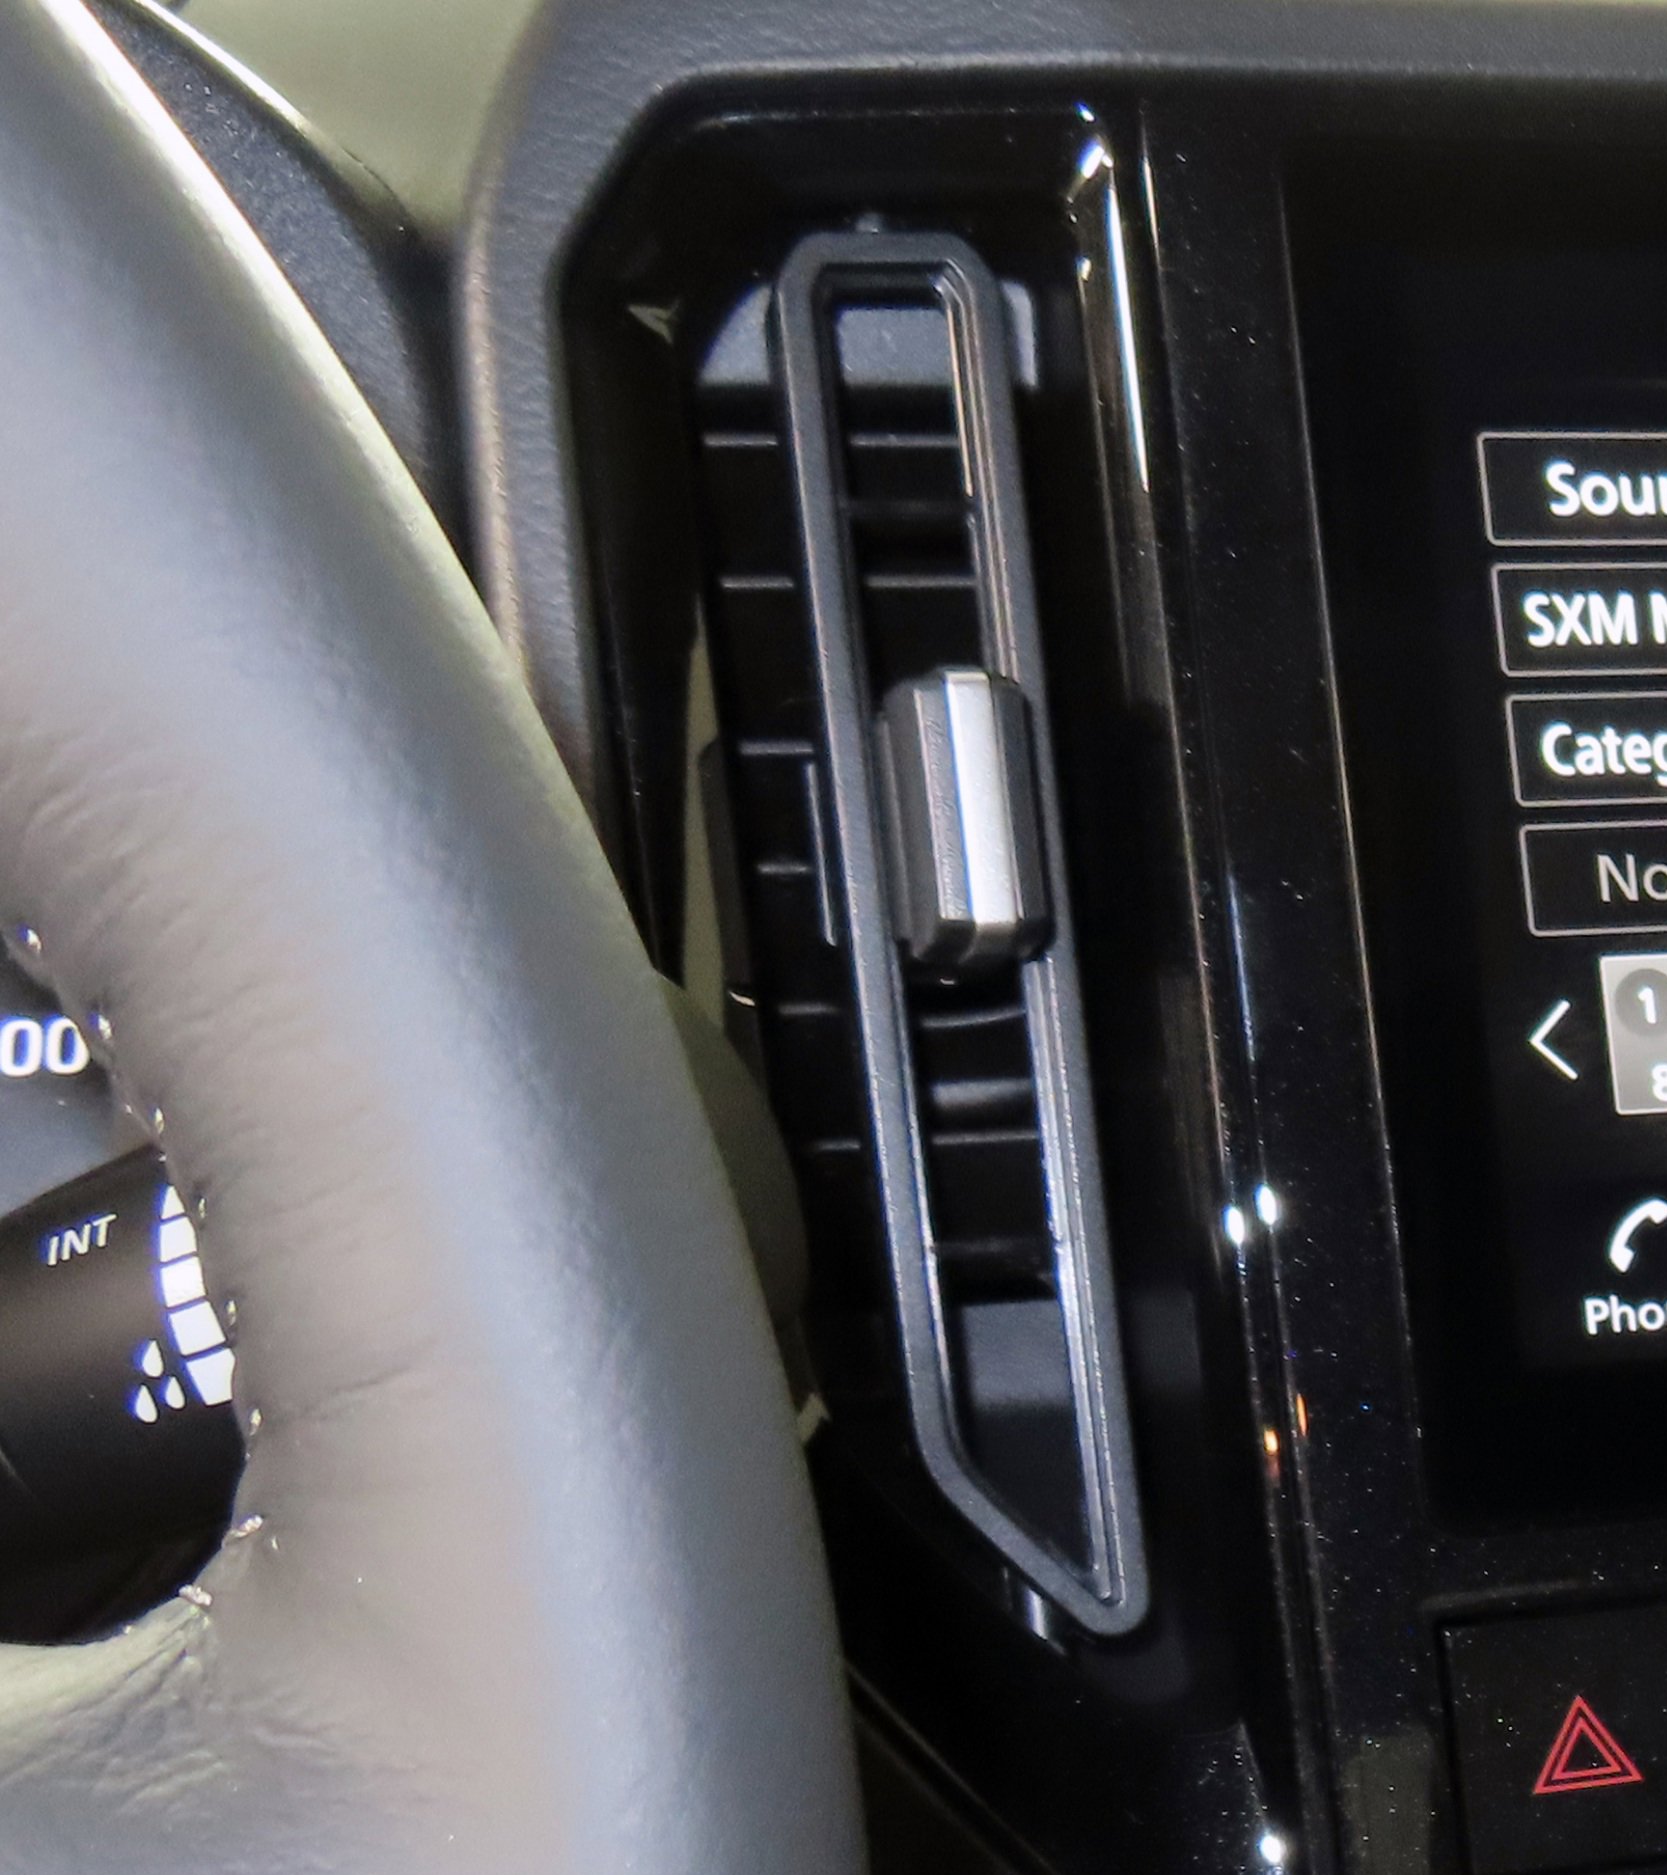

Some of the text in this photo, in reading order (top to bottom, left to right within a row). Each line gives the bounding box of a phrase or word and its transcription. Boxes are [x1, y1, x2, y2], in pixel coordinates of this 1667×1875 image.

[1523, 593, 1639, 648] SXM
[1637, 987, 1657, 1024] 1
[46, 1213, 117, 1266] INT
